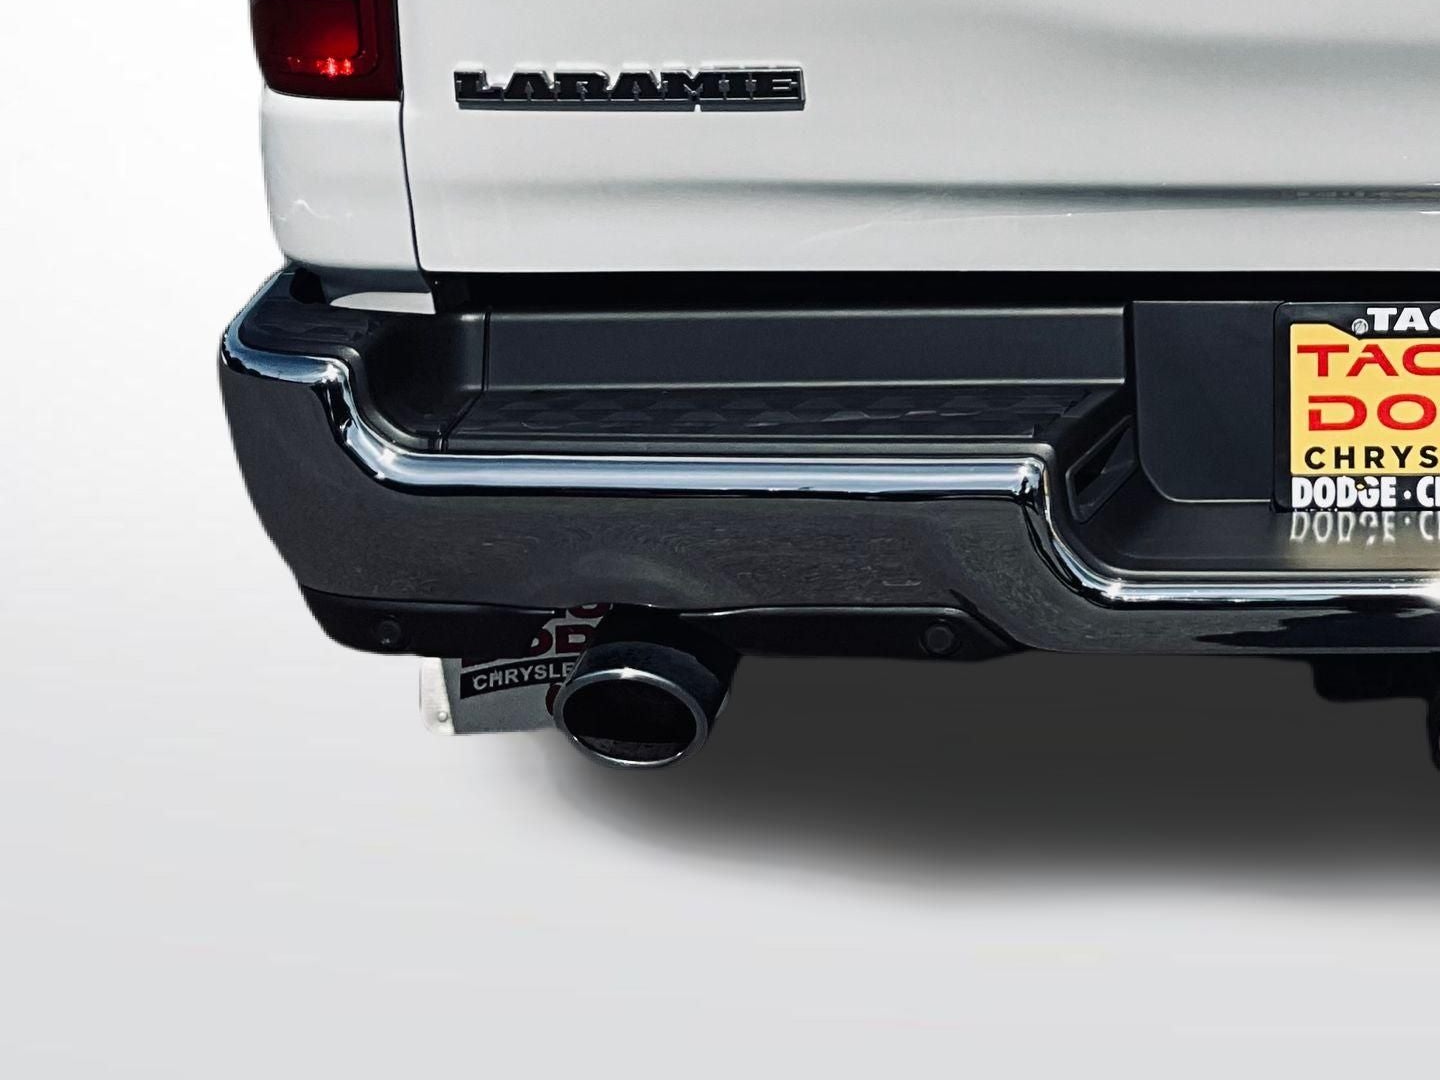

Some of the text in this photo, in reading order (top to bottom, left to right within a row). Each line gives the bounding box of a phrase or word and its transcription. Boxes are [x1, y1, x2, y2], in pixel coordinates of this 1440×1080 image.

[454, 69, 806, 111] LARAMIE
[1291, 476, 1397, 508] DODGE
[471, 661, 578, 691] CHRYSLE
